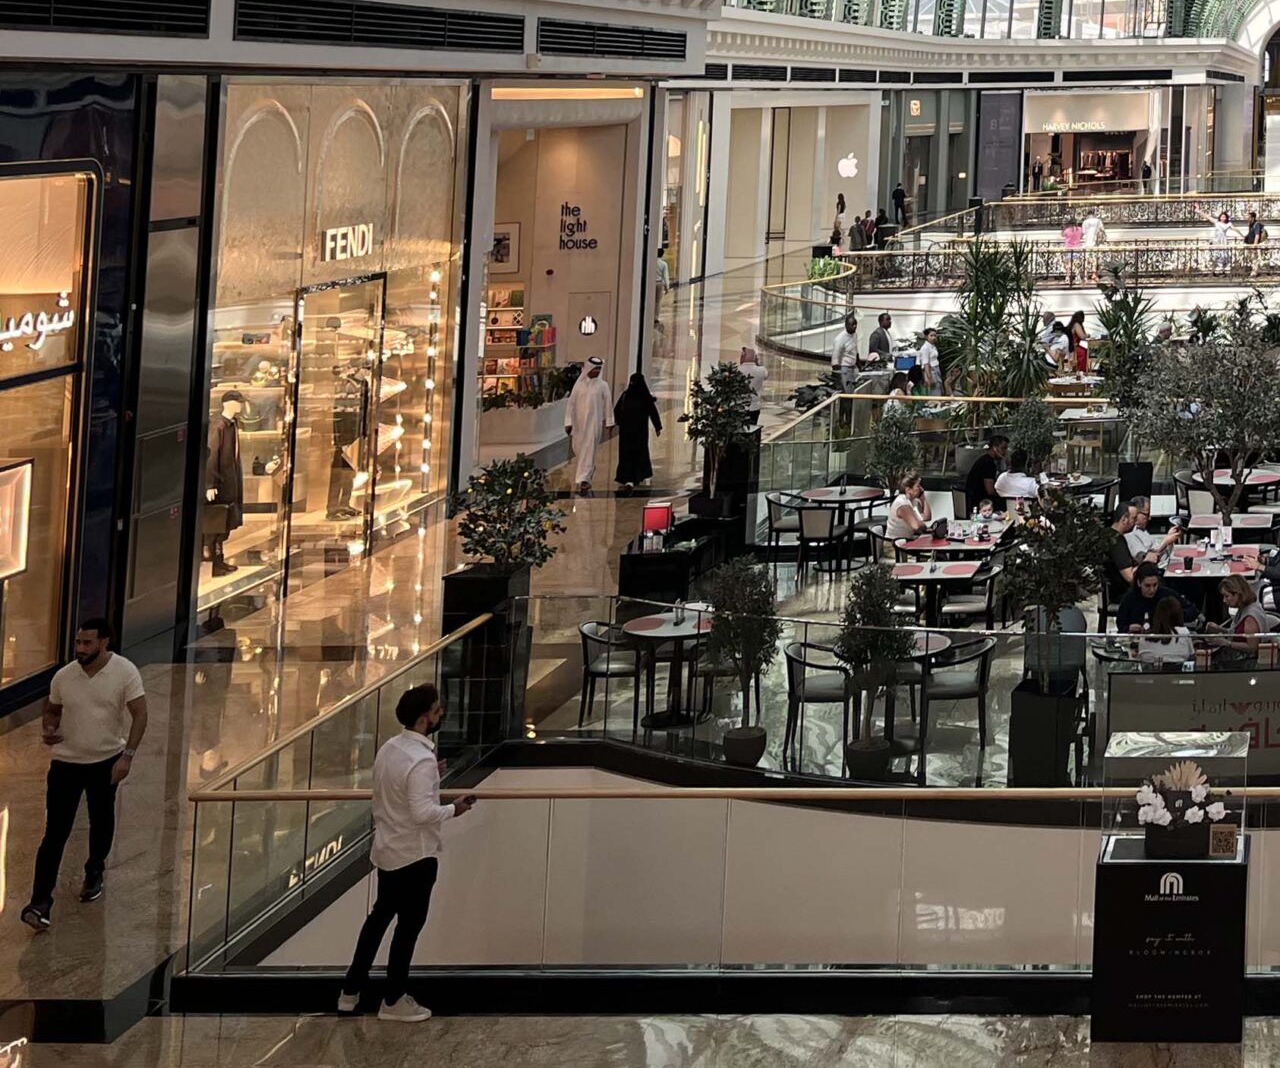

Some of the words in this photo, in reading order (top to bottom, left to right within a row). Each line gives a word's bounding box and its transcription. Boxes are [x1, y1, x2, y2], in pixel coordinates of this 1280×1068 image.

[1042, 122, 1070, 132] HARVEY
[1071, 121, 1106, 131] NICHOLS
[560, 201, 581, 217] the
[560, 217, 587, 237] light
[325, 223, 373, 262] FENDI
[559, 234, 598, 250] house
[0, 291, 75, 352] شومي
